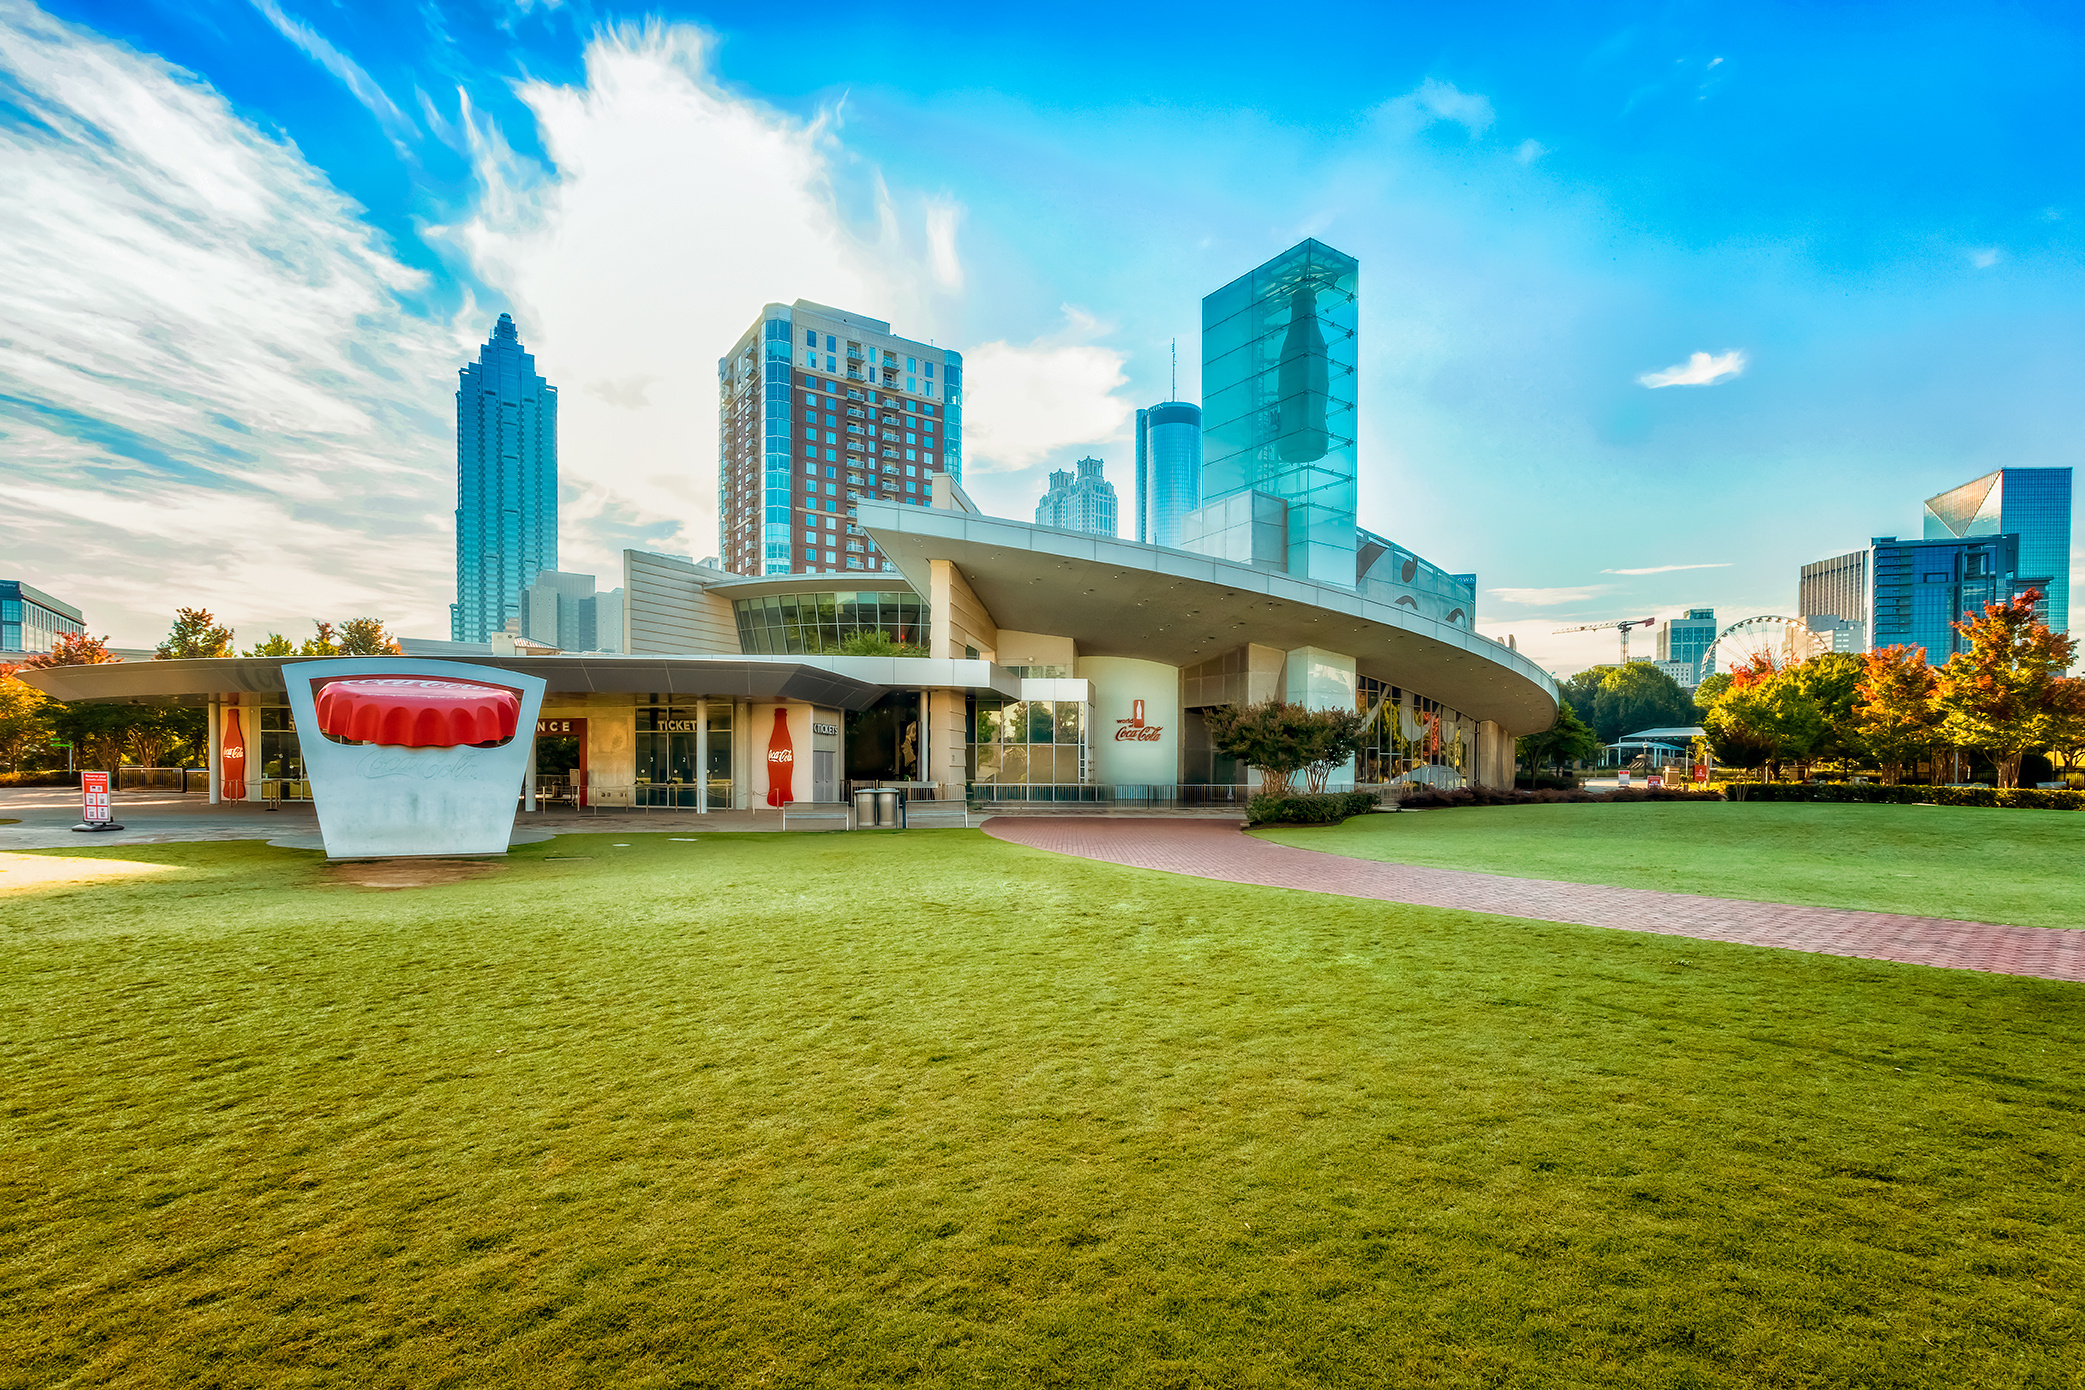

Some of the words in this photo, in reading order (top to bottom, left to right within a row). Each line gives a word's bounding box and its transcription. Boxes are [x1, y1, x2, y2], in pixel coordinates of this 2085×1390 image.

[537, 721, 570, 732] NCE
[658, 720, 698, 731] TICKET
[817, 723, 839, 735] TICKETS
[1115, 726, 1164, 742] Coca-Cola
